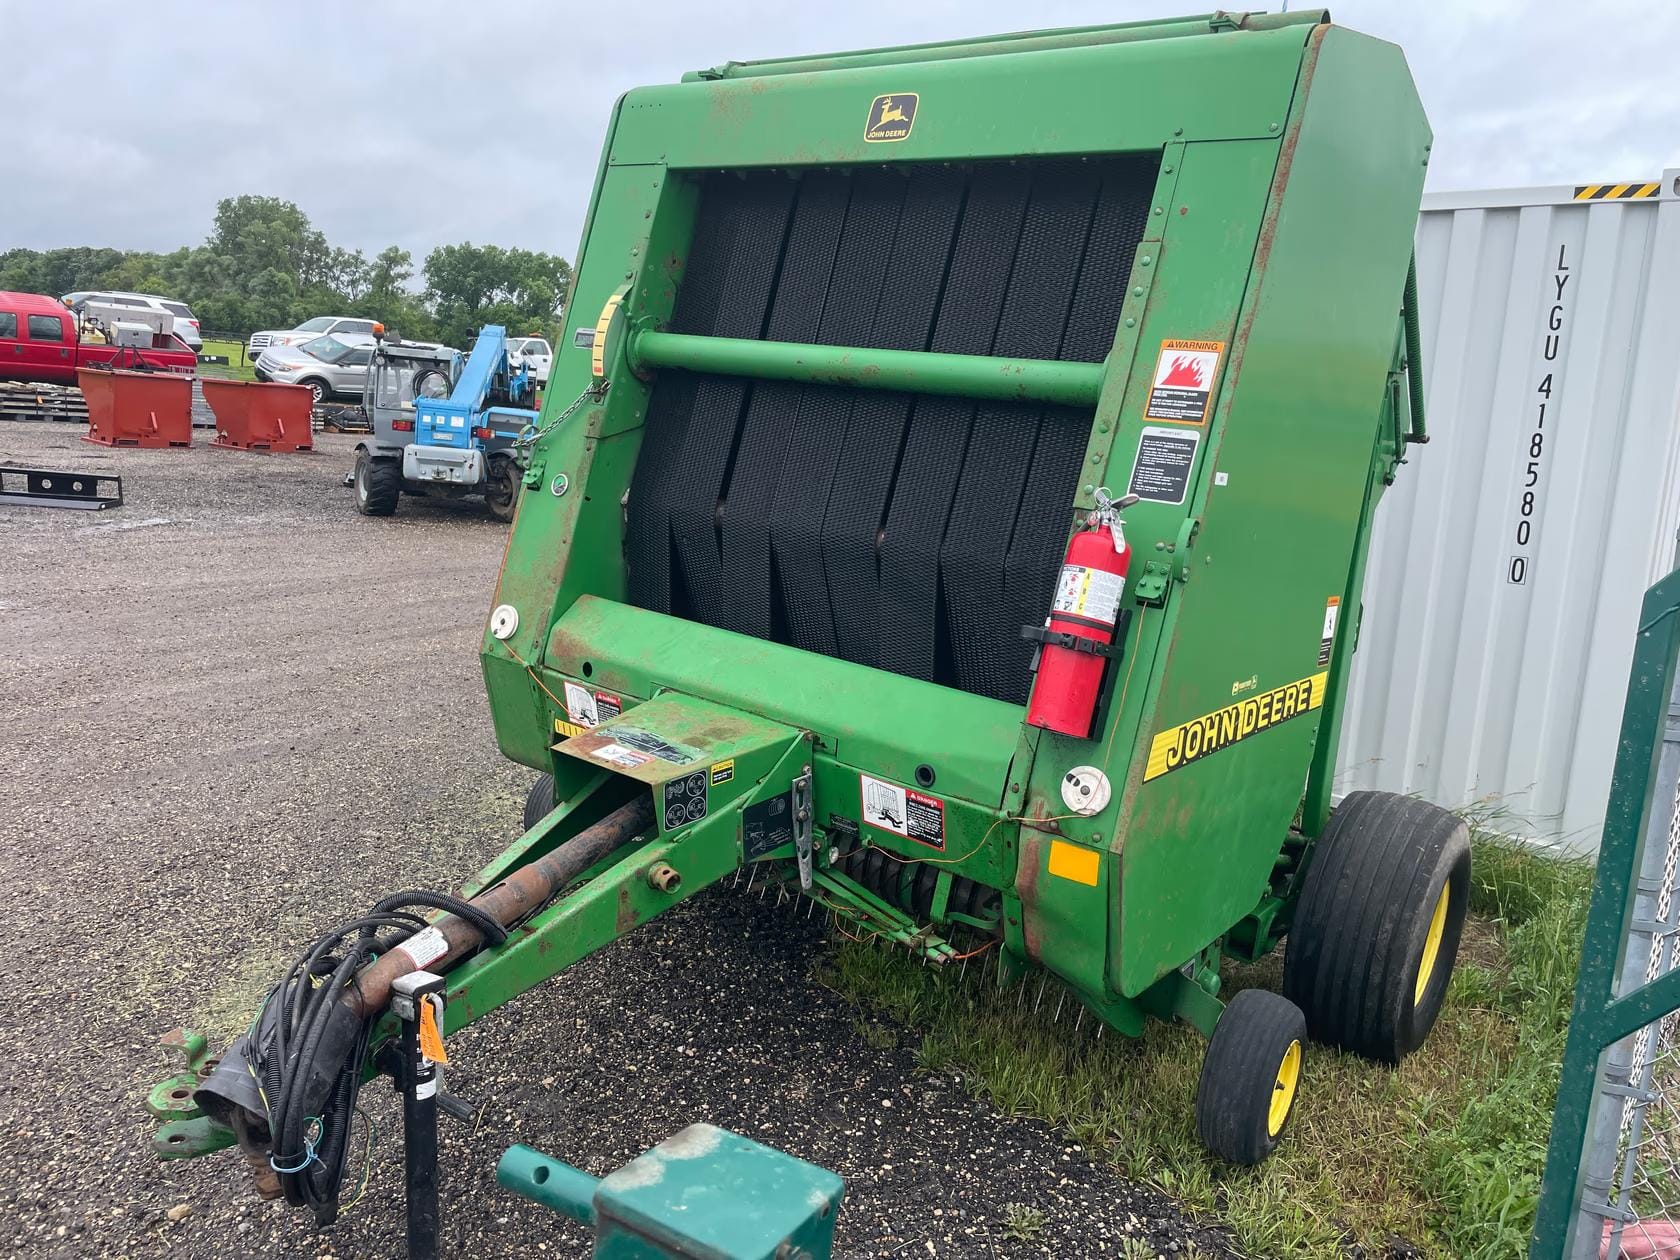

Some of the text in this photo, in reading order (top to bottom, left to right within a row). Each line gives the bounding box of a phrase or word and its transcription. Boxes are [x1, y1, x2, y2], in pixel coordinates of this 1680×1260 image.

[1175, 341, 1218, 351] WARNING
[1511, 244, 1570, 583] LYGU 418580 0
[1166, 679, 1313, 770] JOHN DEERE
